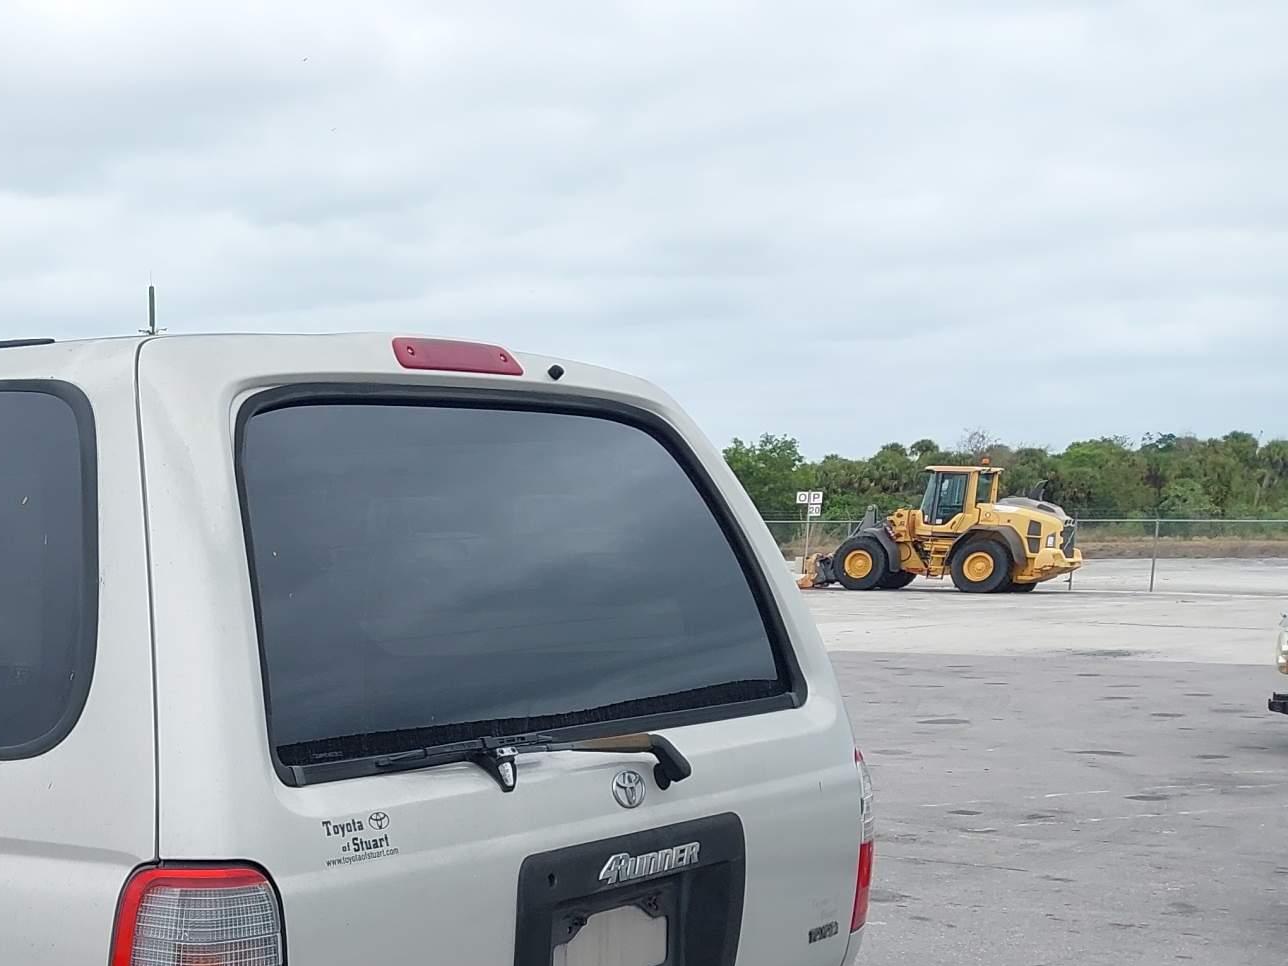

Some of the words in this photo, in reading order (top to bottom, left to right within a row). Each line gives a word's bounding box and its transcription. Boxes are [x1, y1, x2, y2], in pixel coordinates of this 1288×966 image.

[322, 819, 364, 837] Toyota
[342, 842, 351, 852] of
[352, 834, 389, 852] Stuart
[326, 848, 399, 866] www.toyotaofstuart.com
